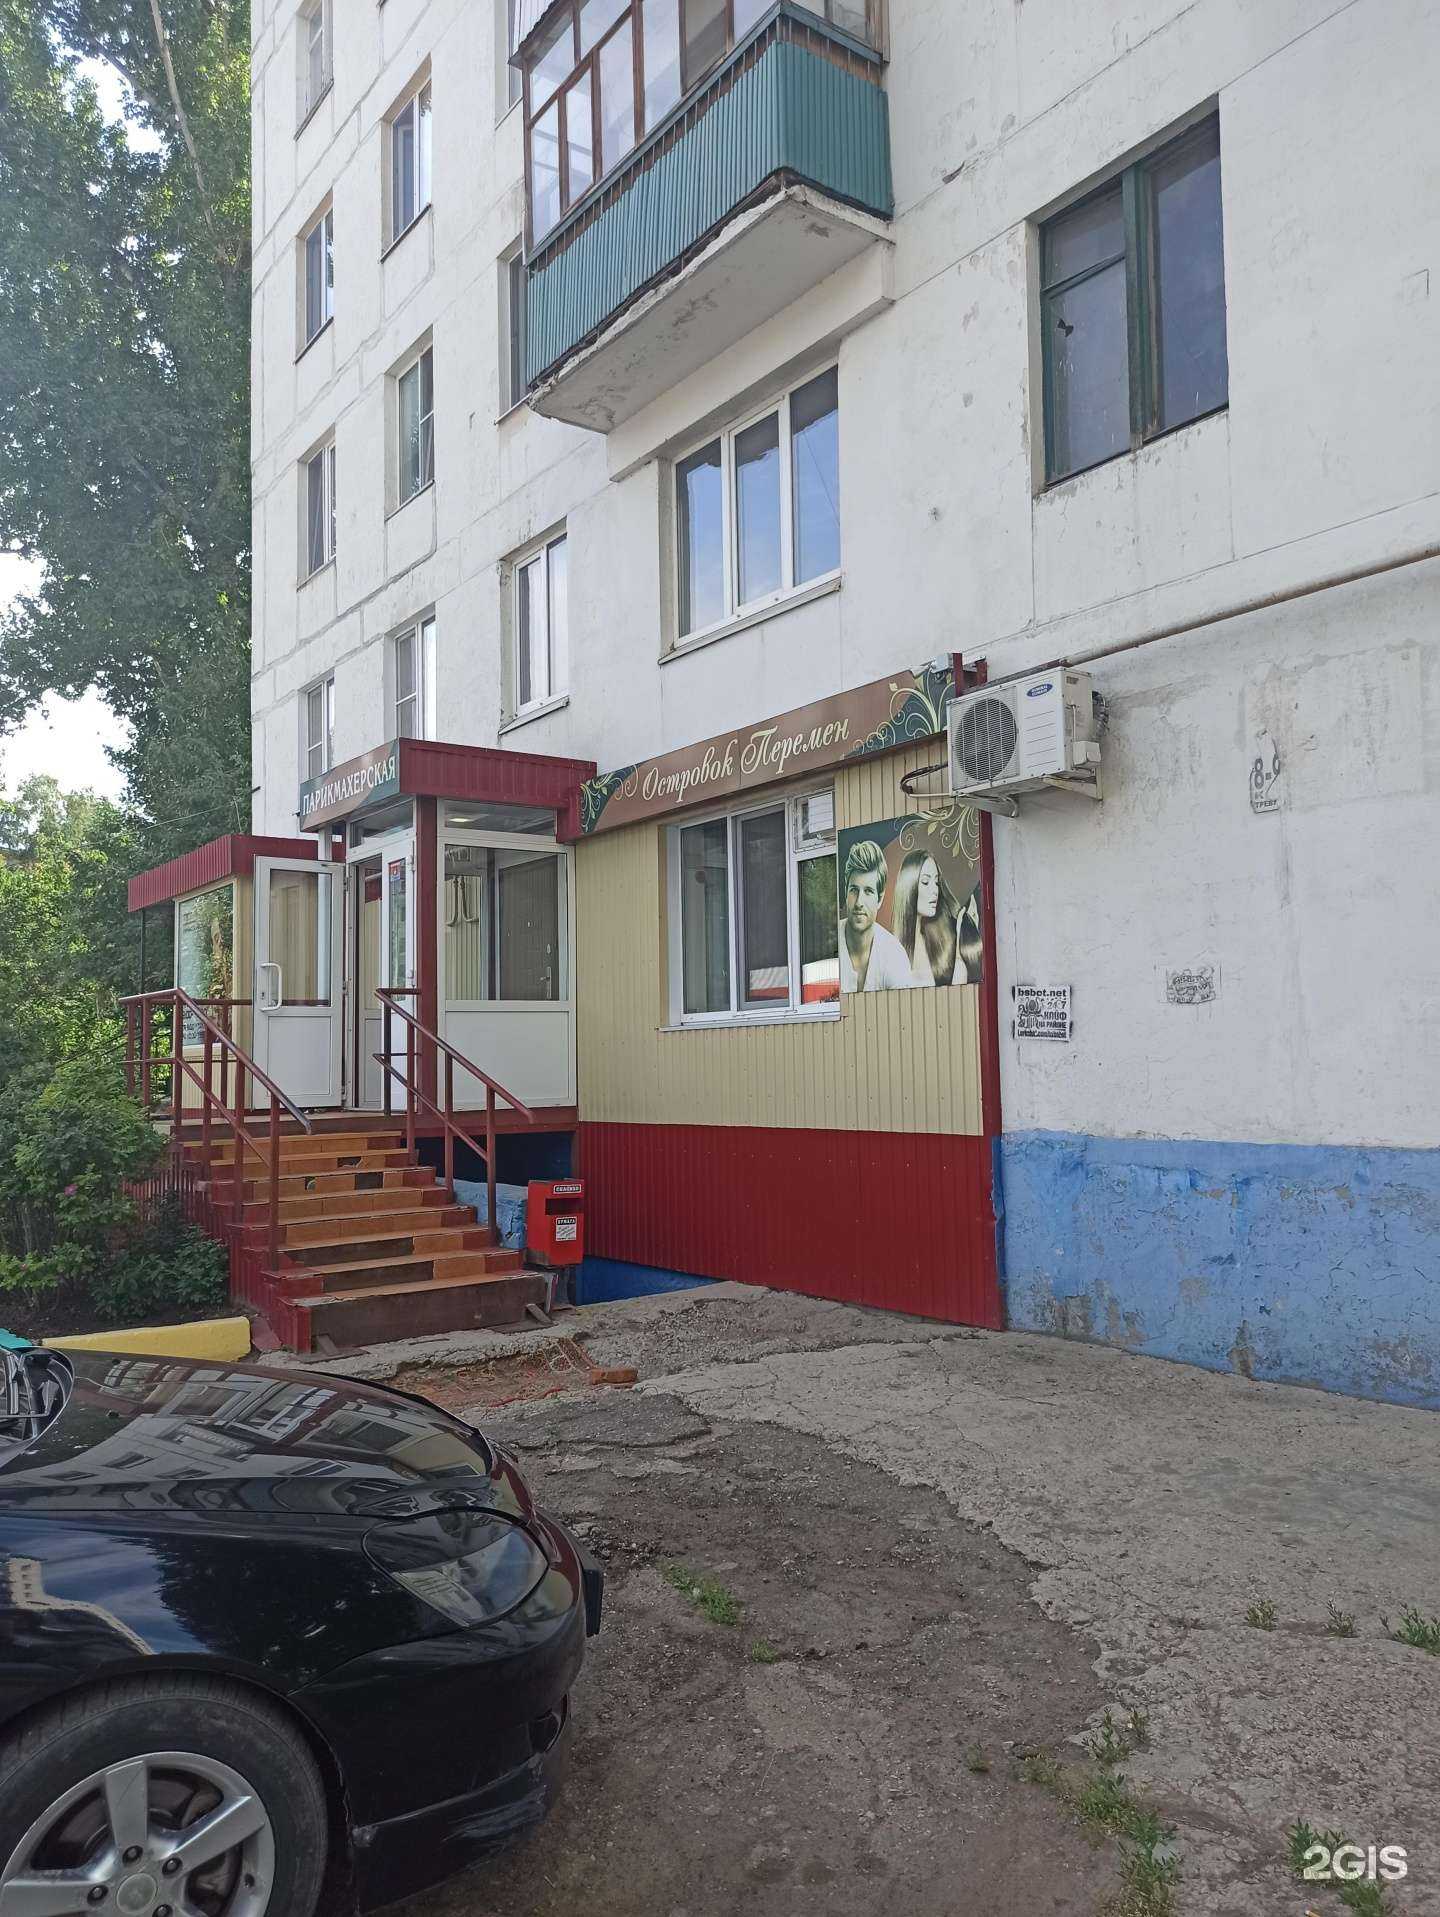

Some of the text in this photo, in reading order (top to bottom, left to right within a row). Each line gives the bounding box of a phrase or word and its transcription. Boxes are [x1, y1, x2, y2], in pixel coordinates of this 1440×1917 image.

[302, 755, 396, 816] ПАРИКМАХЕРСКАЯ
[642, 717, 850, 802] Островок Перемен
[1018, 988, 1066, 996] bsbot.net
